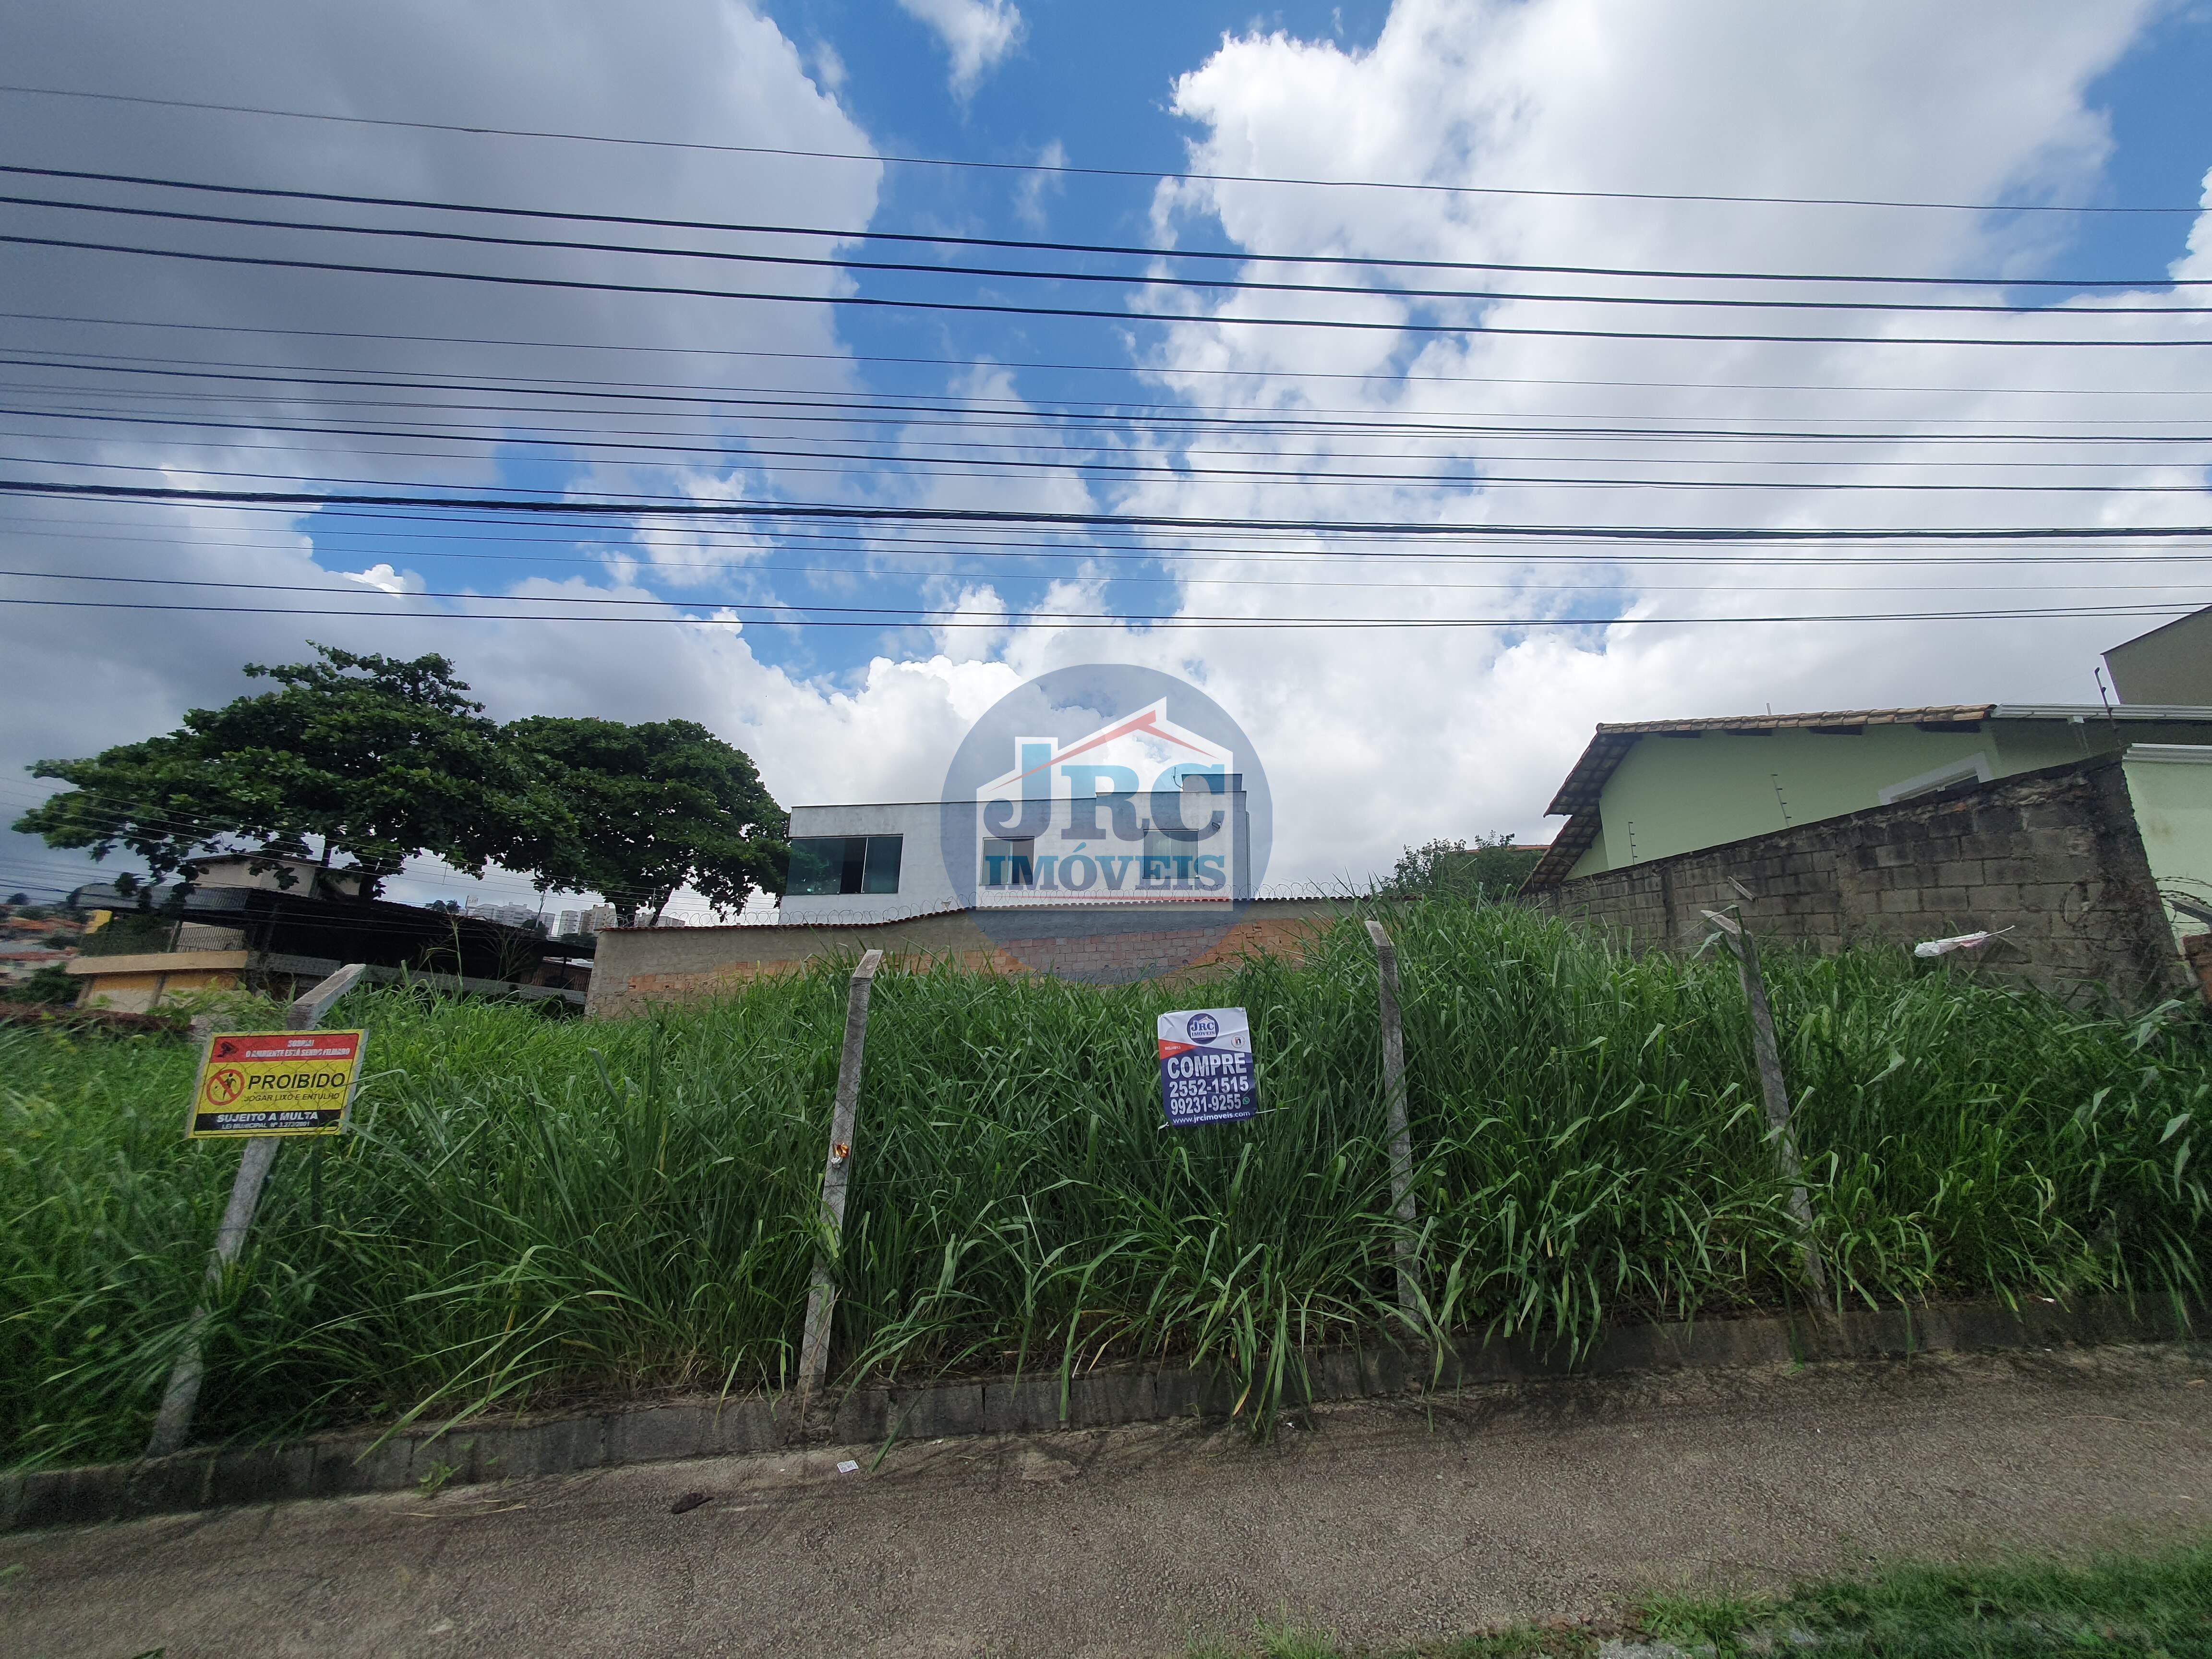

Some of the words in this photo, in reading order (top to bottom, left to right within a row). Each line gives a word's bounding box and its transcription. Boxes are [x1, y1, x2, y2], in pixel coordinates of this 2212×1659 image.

[1190, 1021, 1214, 1031] JRC
[1167, 1052, 1247, 1079] COMPRE
[247, 1072, 346, 1090] PROIBIDO
[1169, 1076, 1249, 1098] 2552-1515
[1170, 1094, 1241, 1116] 99231-9255
[216, 1113, 266, 1123] SUJEITO
[268, 1113, 277, 1121] A
[279, 1111, 318, 1121] MULTA
[1172, 1111, 1250, 1124] www.jrcimoveis.com
